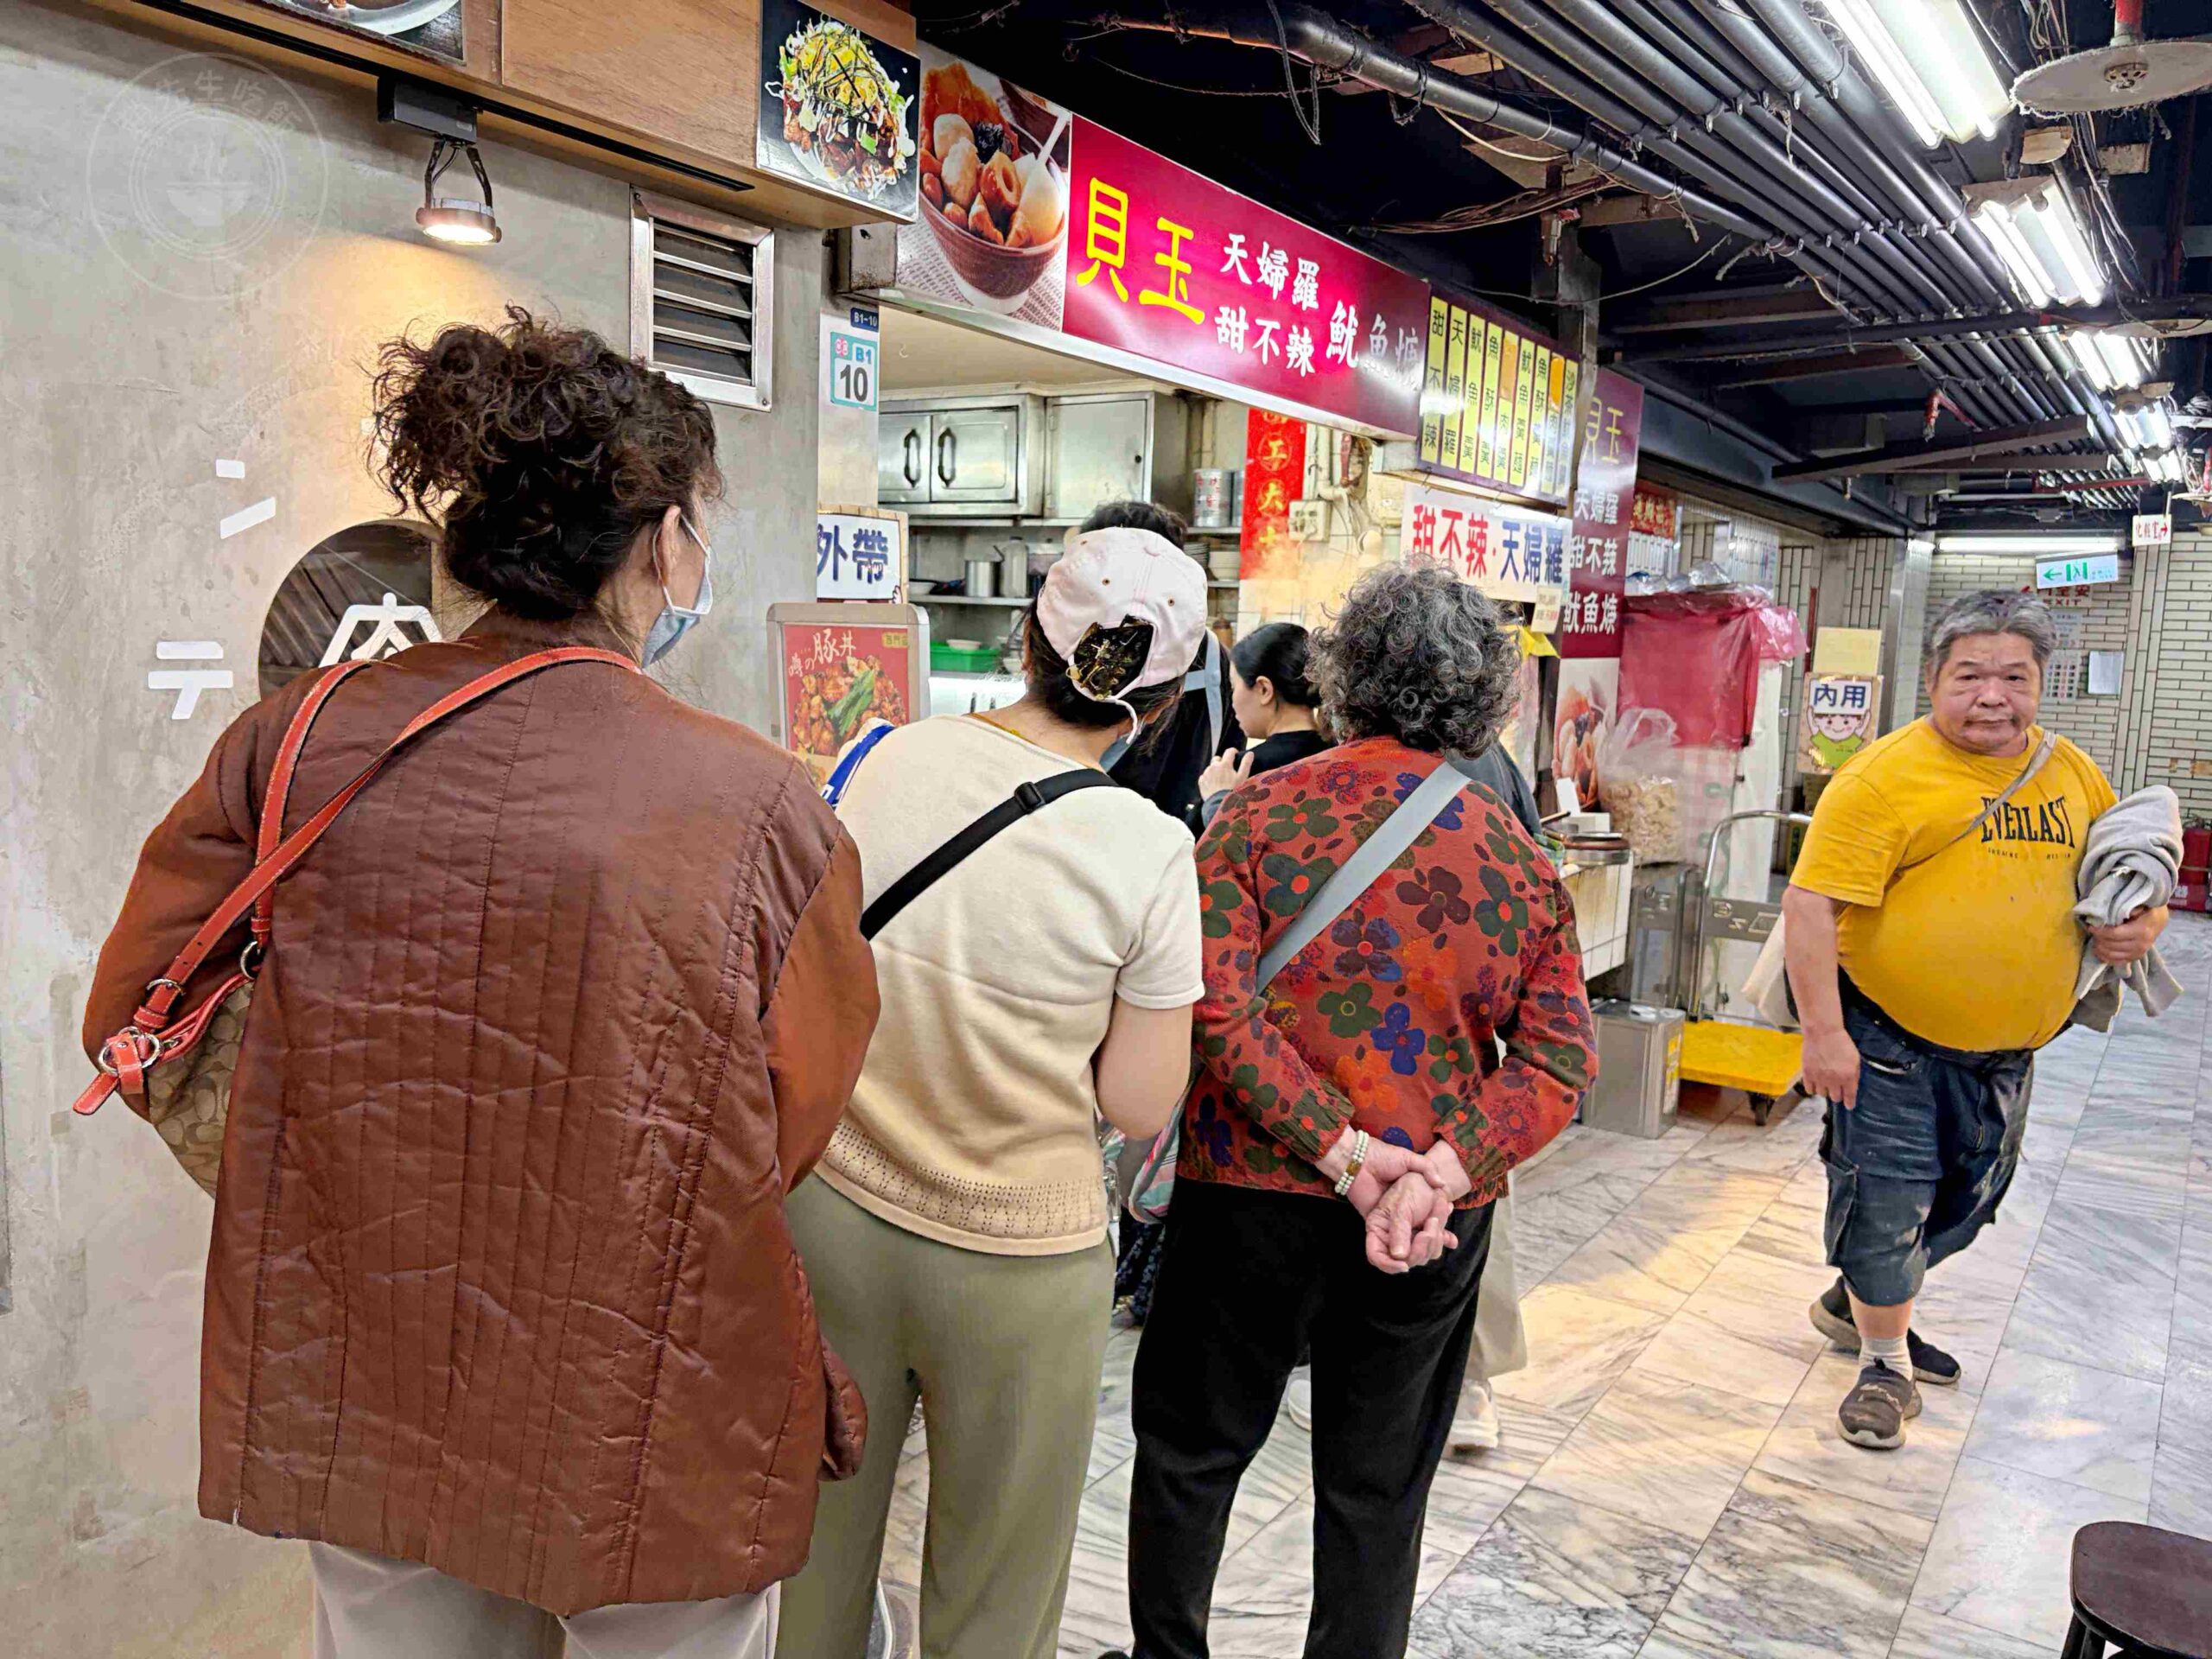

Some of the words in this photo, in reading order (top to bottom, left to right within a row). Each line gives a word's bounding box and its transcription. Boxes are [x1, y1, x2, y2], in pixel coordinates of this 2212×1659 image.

[1076, 177, 1205, 325] 貝玉
[1219, 232, 1321, 311] 天婦羅
[854, 312, 878, 327] B1-10
[1214, 305, 1316, 378] 甜不辣
[840, 364, 868, 402] 10
[855, 346, 872, 365] B1
[817, 524, 889, 584] 外帶
[147, 640, 234, 720] テ
